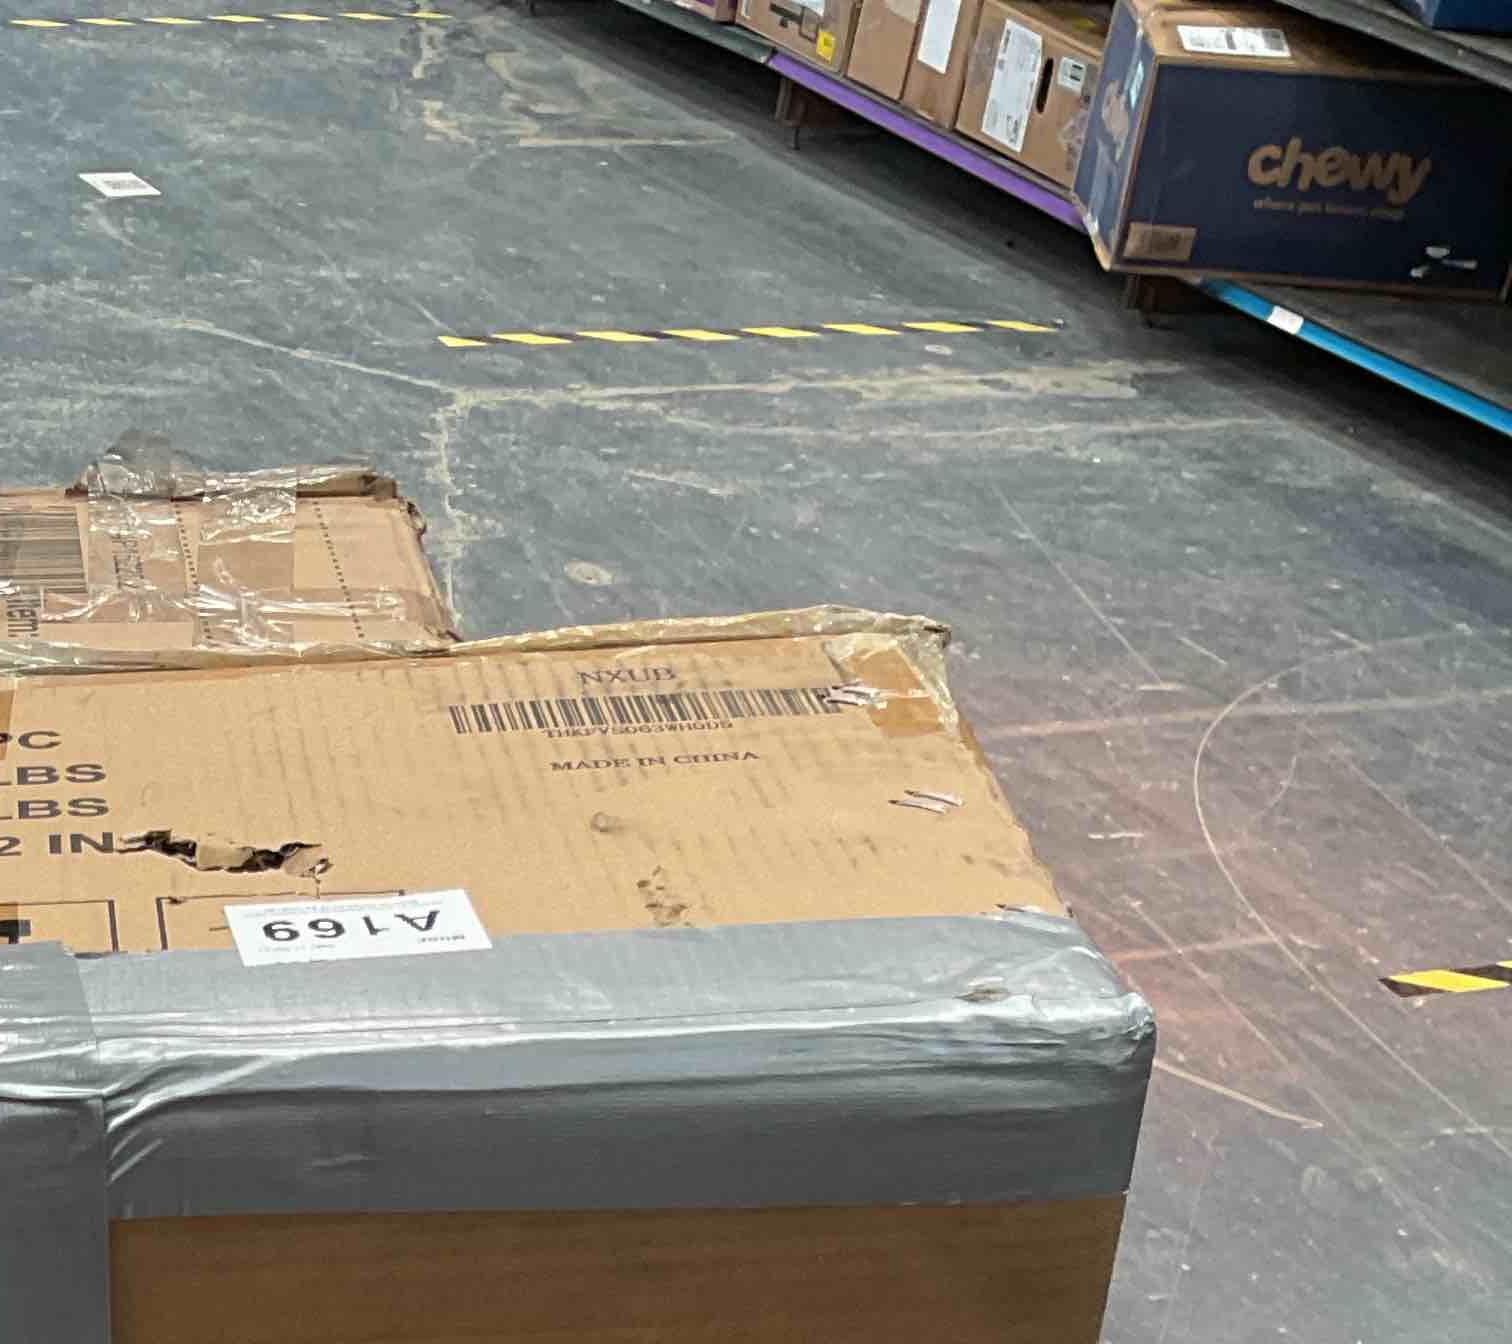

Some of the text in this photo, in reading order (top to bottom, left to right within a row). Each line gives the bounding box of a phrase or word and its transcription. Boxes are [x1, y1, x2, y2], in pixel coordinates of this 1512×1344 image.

[1248, 136, 1431, 204] chewy
[550, 751, 761, 771] MADE IN CHINA
[263, 908, 441, 943] A169
